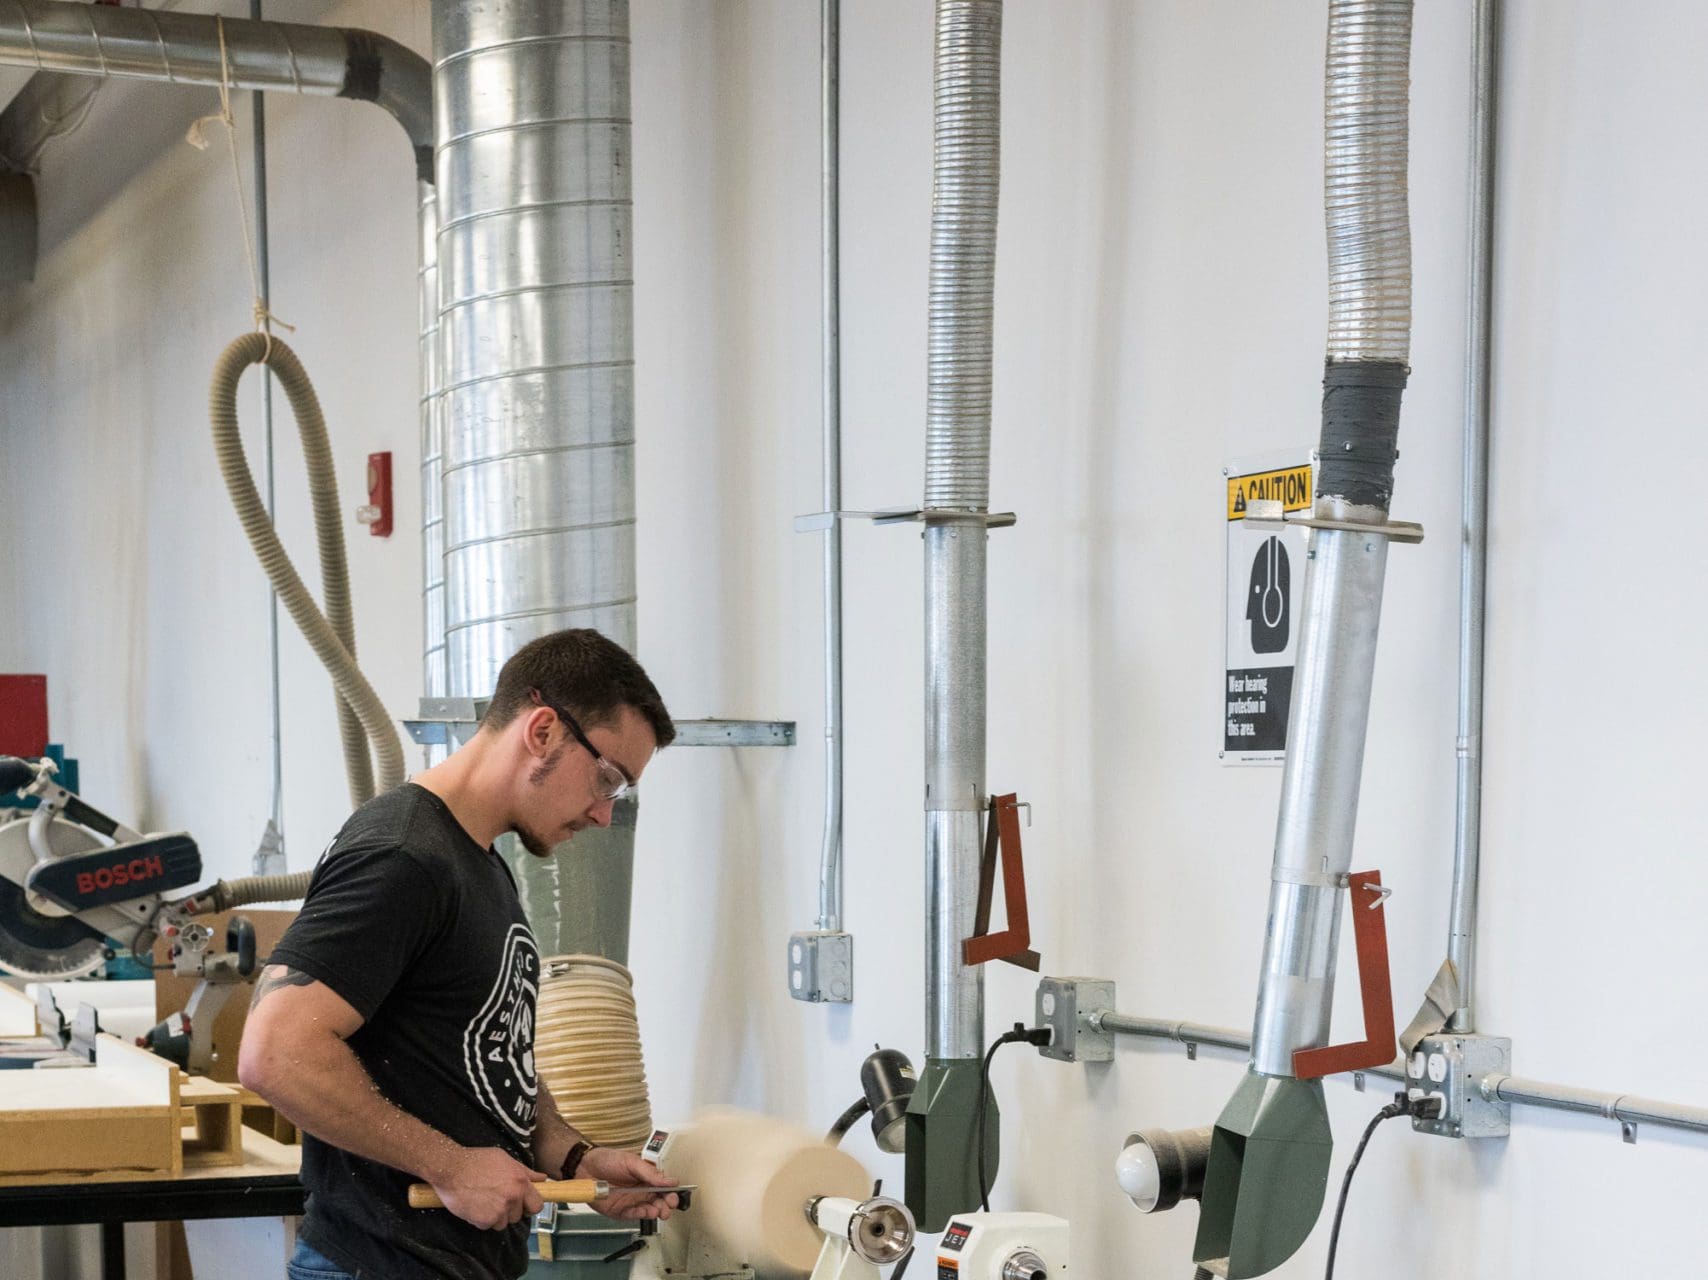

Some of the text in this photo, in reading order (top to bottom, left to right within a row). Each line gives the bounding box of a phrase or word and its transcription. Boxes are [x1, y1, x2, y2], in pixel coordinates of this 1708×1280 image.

[1250, 472, 1306, 505] CAUTION
[1228, 673, 1268, 694] Wear hearing
[1228, 696, 1266, 718] protection in
[1228, 719, 1256, 736] this area.
[76, 856, 164, 895] BOSCH
[649, 1138, 663, 1149] JET
[945, 1234, 965, 1245] JET
